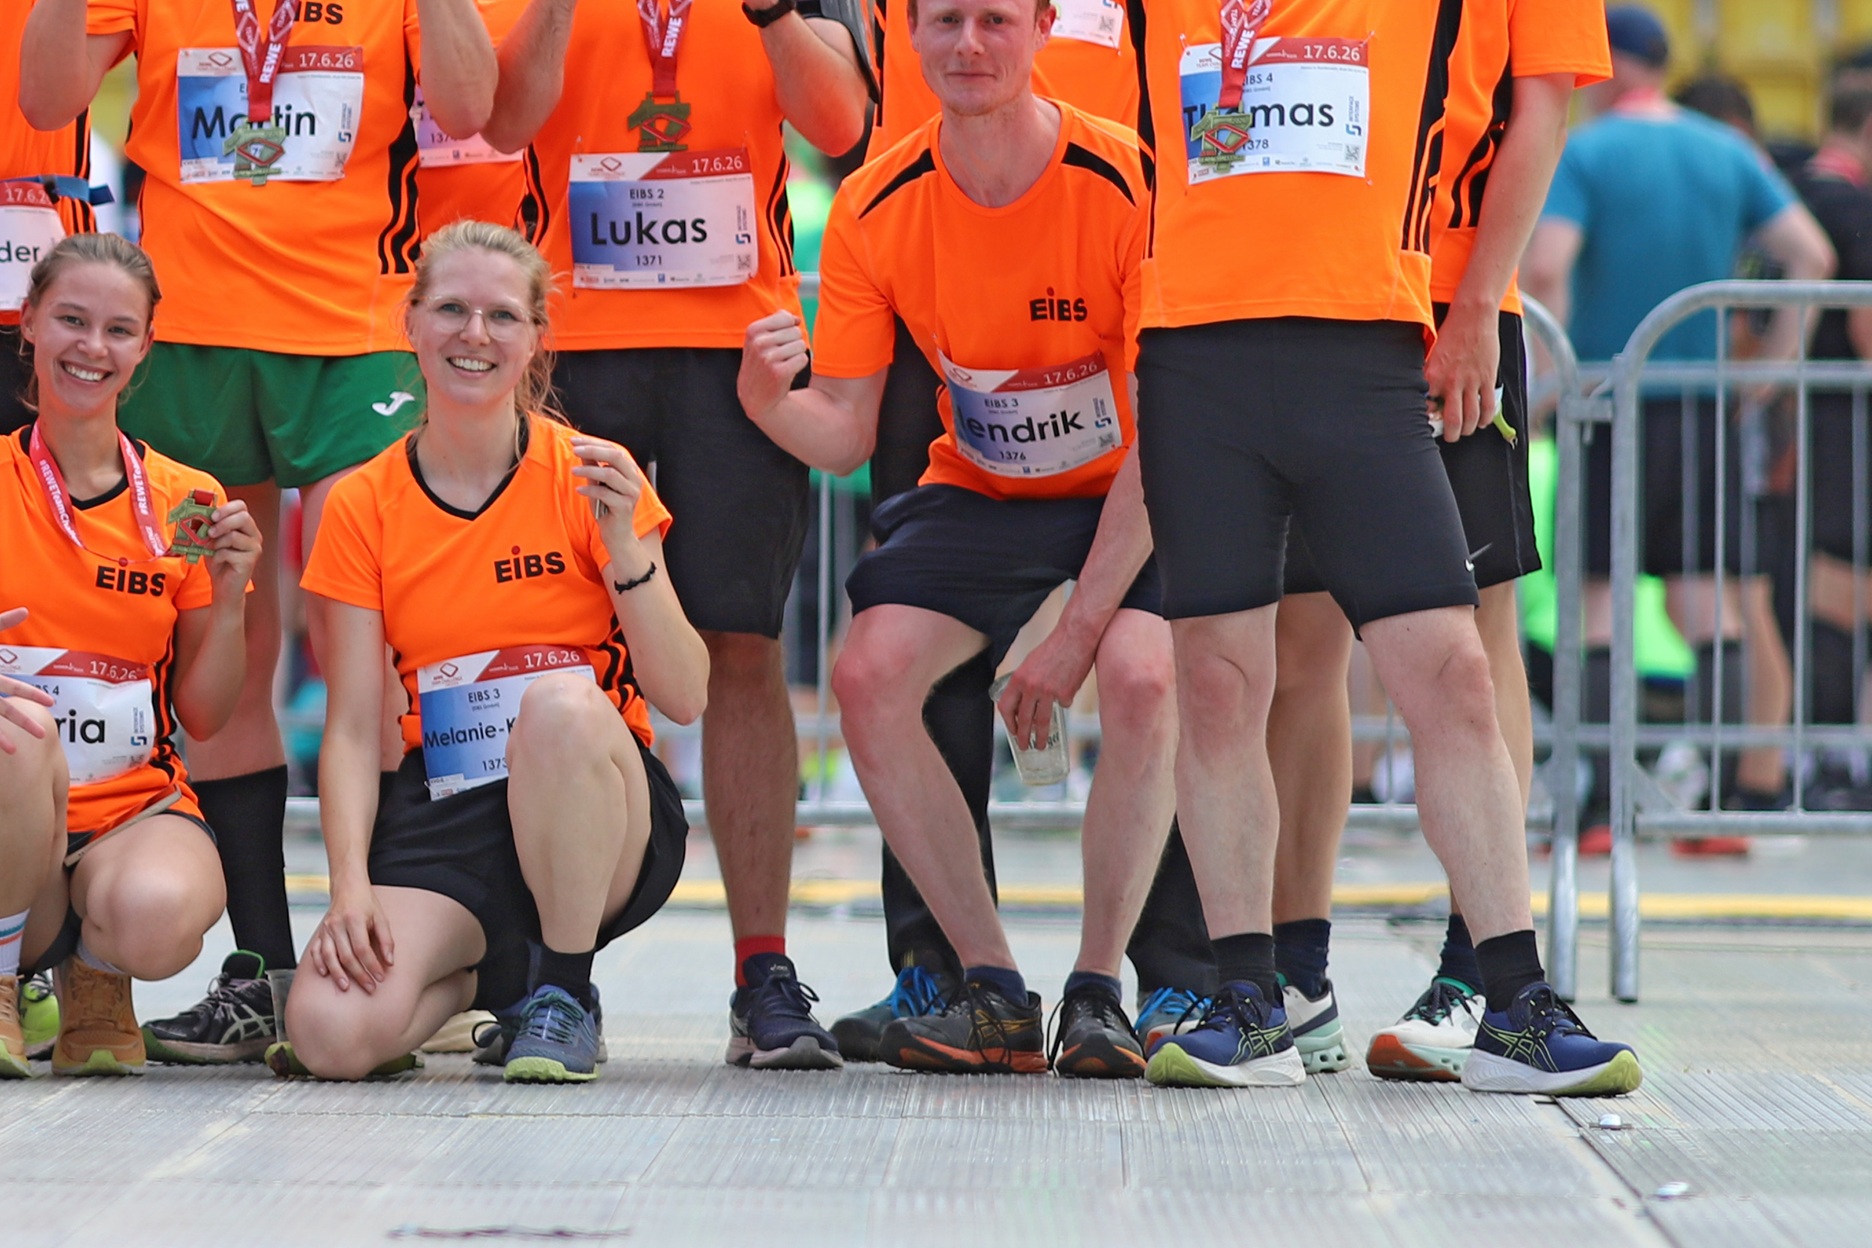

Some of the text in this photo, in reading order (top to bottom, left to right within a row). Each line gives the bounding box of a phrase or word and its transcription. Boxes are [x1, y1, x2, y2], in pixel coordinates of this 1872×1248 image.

[661, 17, 682, 58] REWE
[1231, 29, 1255, 69] REWE
[1303, 44, 1361, 62] 17.6.26
[259, 42, 282, 84] REWE
[299, 52, 355, 69] 17.6.26
[1244, 72, 1274, 85] IBS 4
[192, 103, 316, 140] Mtin
[1184, 102, 1334, 136] Tmas
[692, 155, 743, 174] 17.6.26
[629, 187, 665, 200] EIBS 2
[591, 211, 708, 246] Lukas
[635, 254, 663, 266] 1371
[1043, 360, 1098, 386] 17.6.26
[984, 397, 1019, 409] EIBS 3
[999, 449, 1027, 462] 1376
[524, 650, 580, 669] 17.6.26
[89, 659, 137, 681] 17.6.26
[52, 685, 59, 696] 4
[468, 688, 501, 703] EIBS 3
[55, 708, 106, 745] ria
[424, 717, 516, 750] Melanie-K
